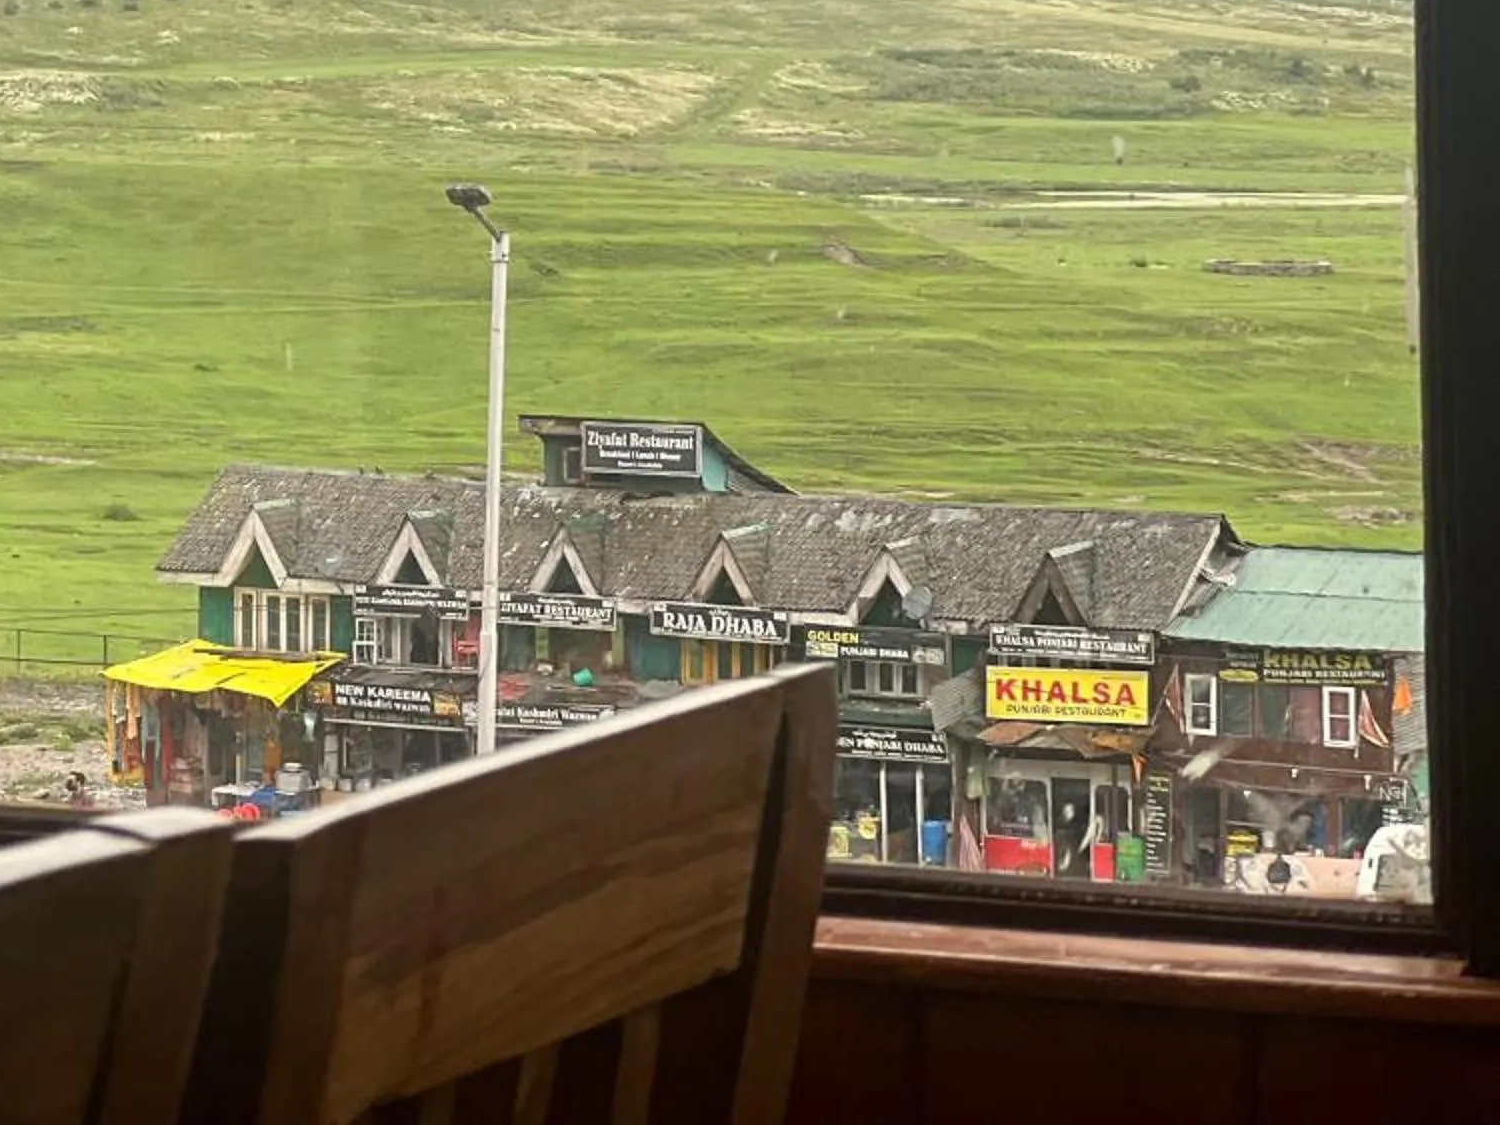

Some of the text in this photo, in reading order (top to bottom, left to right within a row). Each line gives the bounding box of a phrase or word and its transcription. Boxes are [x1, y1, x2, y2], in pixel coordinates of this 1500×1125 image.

[630, 432, 693, 450] Restaurant
[544, 604, 612, 619] RESTAURANT
[663, 612, 777, 636] RAJA DHABA
[807, 630, 859, 644] GOLDEN
[995, 635, 1035, 647] KHALSA
[1264, 650, 1373, 670] KHALSA
[335, 683, 431, 702] NEW KAREEMA
[996, 678, 1136, 706] KHALSA
[1006, 704, 1127, 718] PUNJABI RESTAURANT
[904, 741, 945, 754] DHABA
